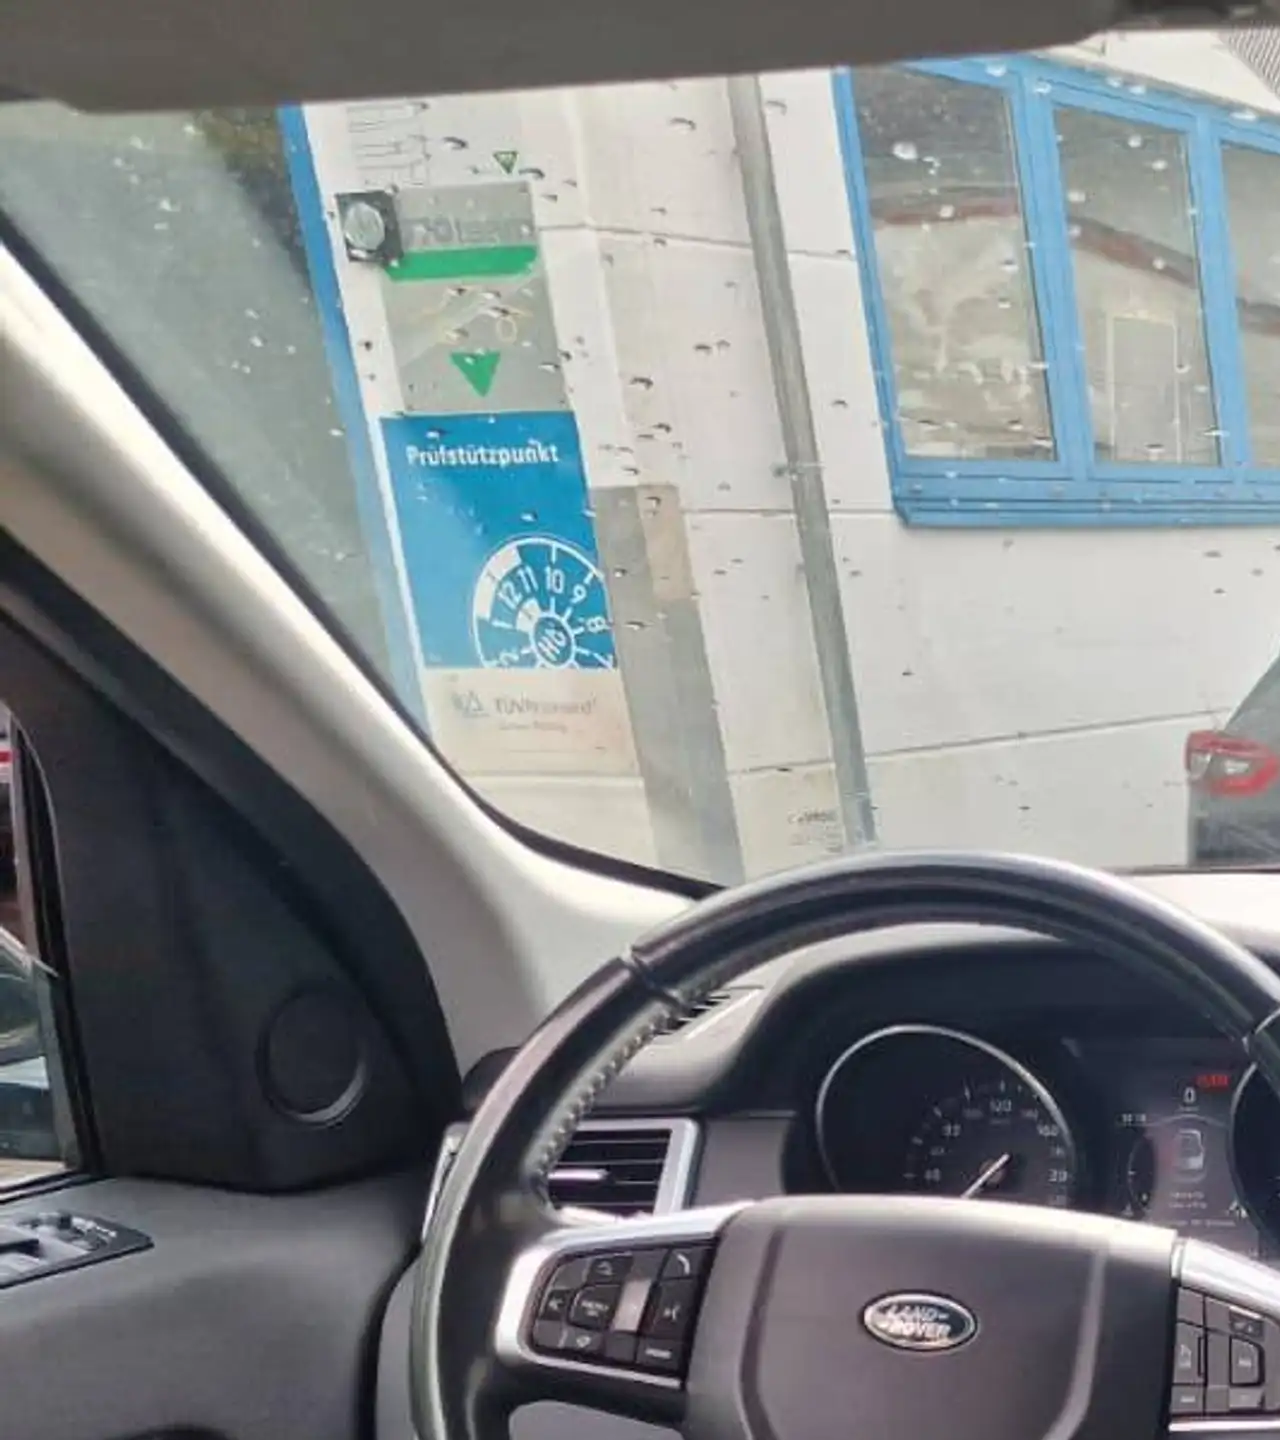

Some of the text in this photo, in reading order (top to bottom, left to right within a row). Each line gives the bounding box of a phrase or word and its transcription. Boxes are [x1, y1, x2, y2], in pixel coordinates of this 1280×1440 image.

[405, 443, 560, 470] Prüfstützpunkt
[498, 581, 524, 611] 12
[516, 565, 539, 593] 11
[544, 566, 566, 594] 10
[572, 585, 587, 604] 9
[586, 616, 606, 632] 8
